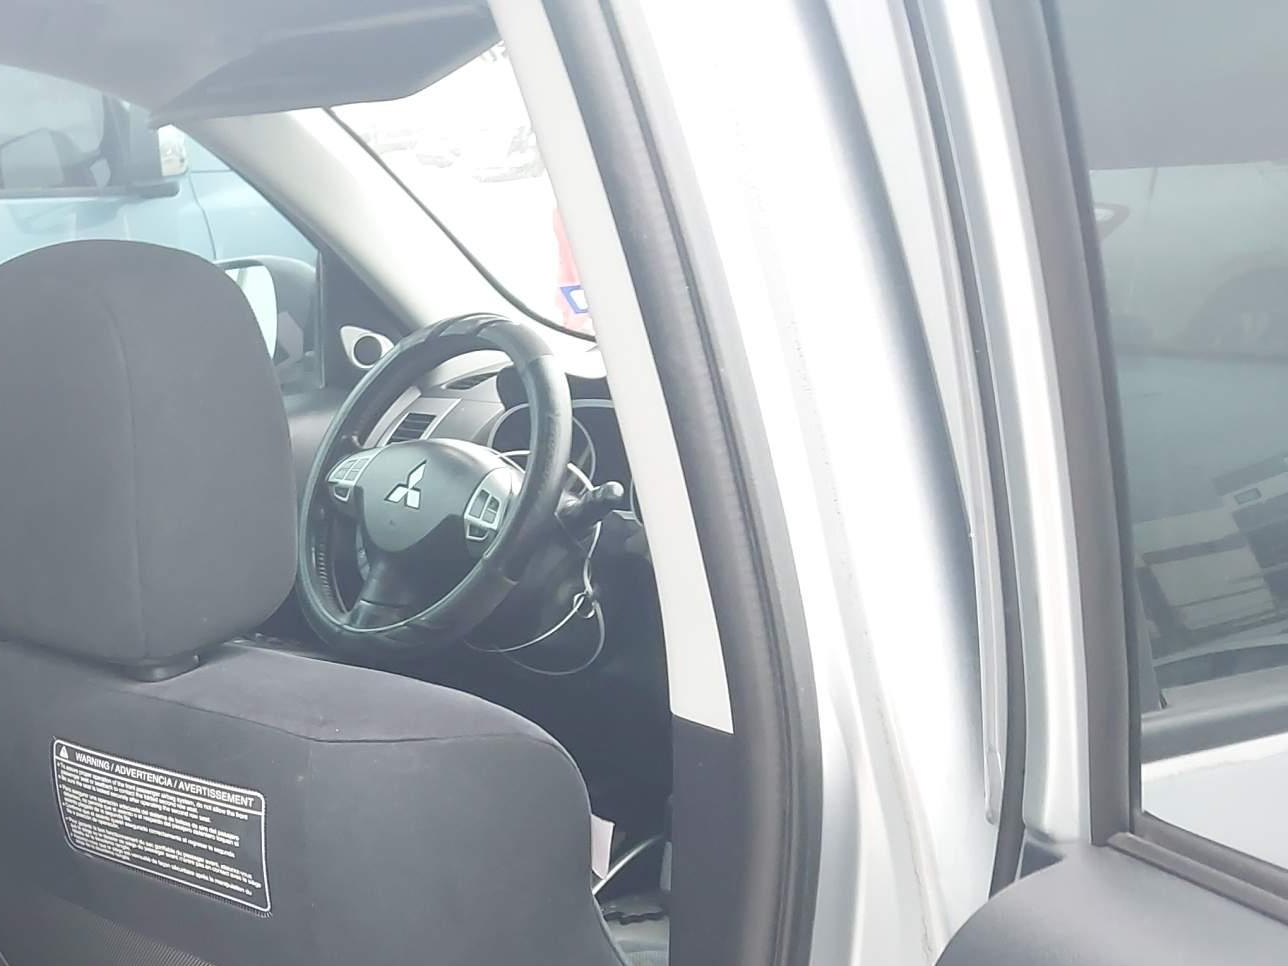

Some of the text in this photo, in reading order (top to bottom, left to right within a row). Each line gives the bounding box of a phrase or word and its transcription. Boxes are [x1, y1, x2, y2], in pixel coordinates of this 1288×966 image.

[75, 751, 110, 771] WARNING
[115, 764, 173, 788] ADVERTENCIA
[178, 780, 255, 808] AVERTISSEMENT
